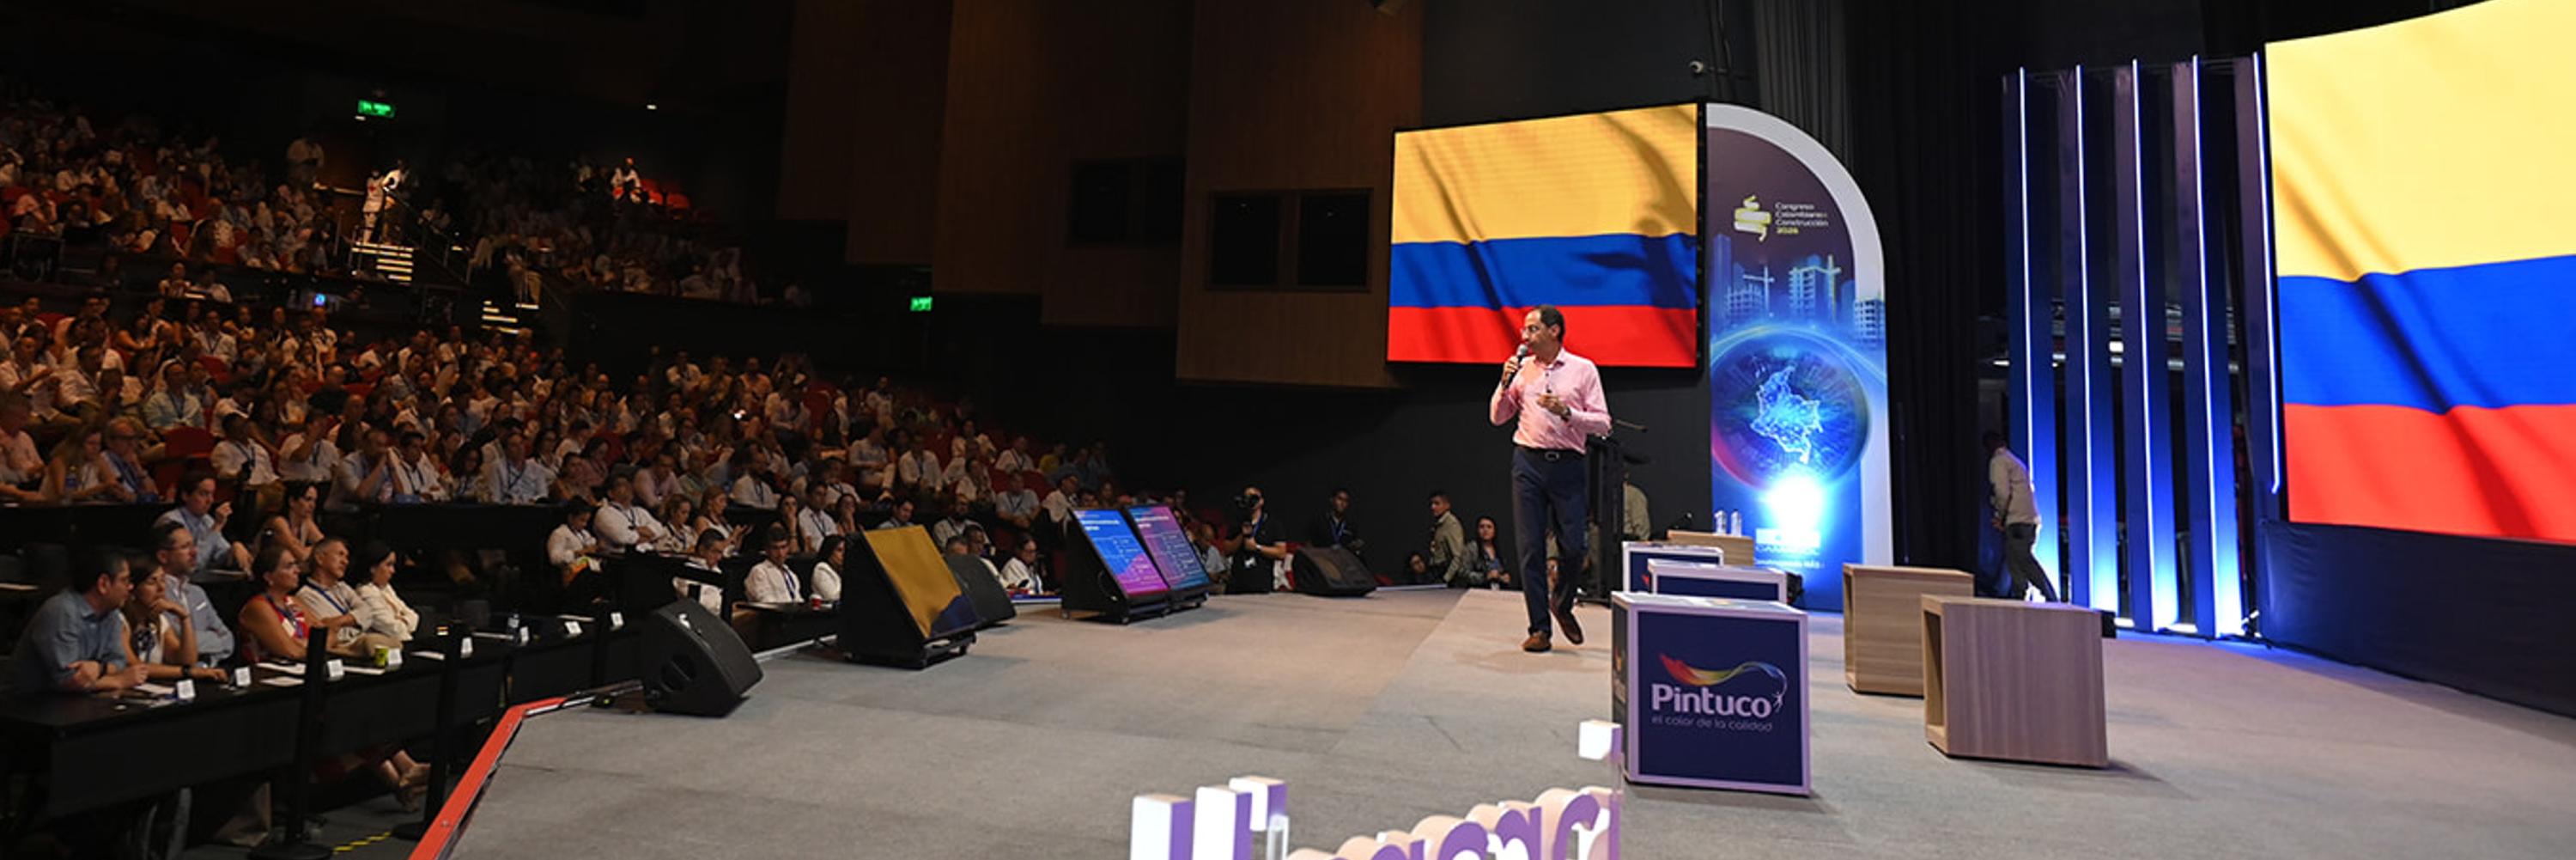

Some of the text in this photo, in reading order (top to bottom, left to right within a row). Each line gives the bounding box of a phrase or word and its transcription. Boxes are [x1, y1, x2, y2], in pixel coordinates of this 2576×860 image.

[1651, 684, 1771, 718] Pintuco
[1665, 717, 1694, 726] color
[1696, 718, 1712, 729] de
[1714, 719, 1727, 729] la
[1728, 722, 1772, 731] calidad
